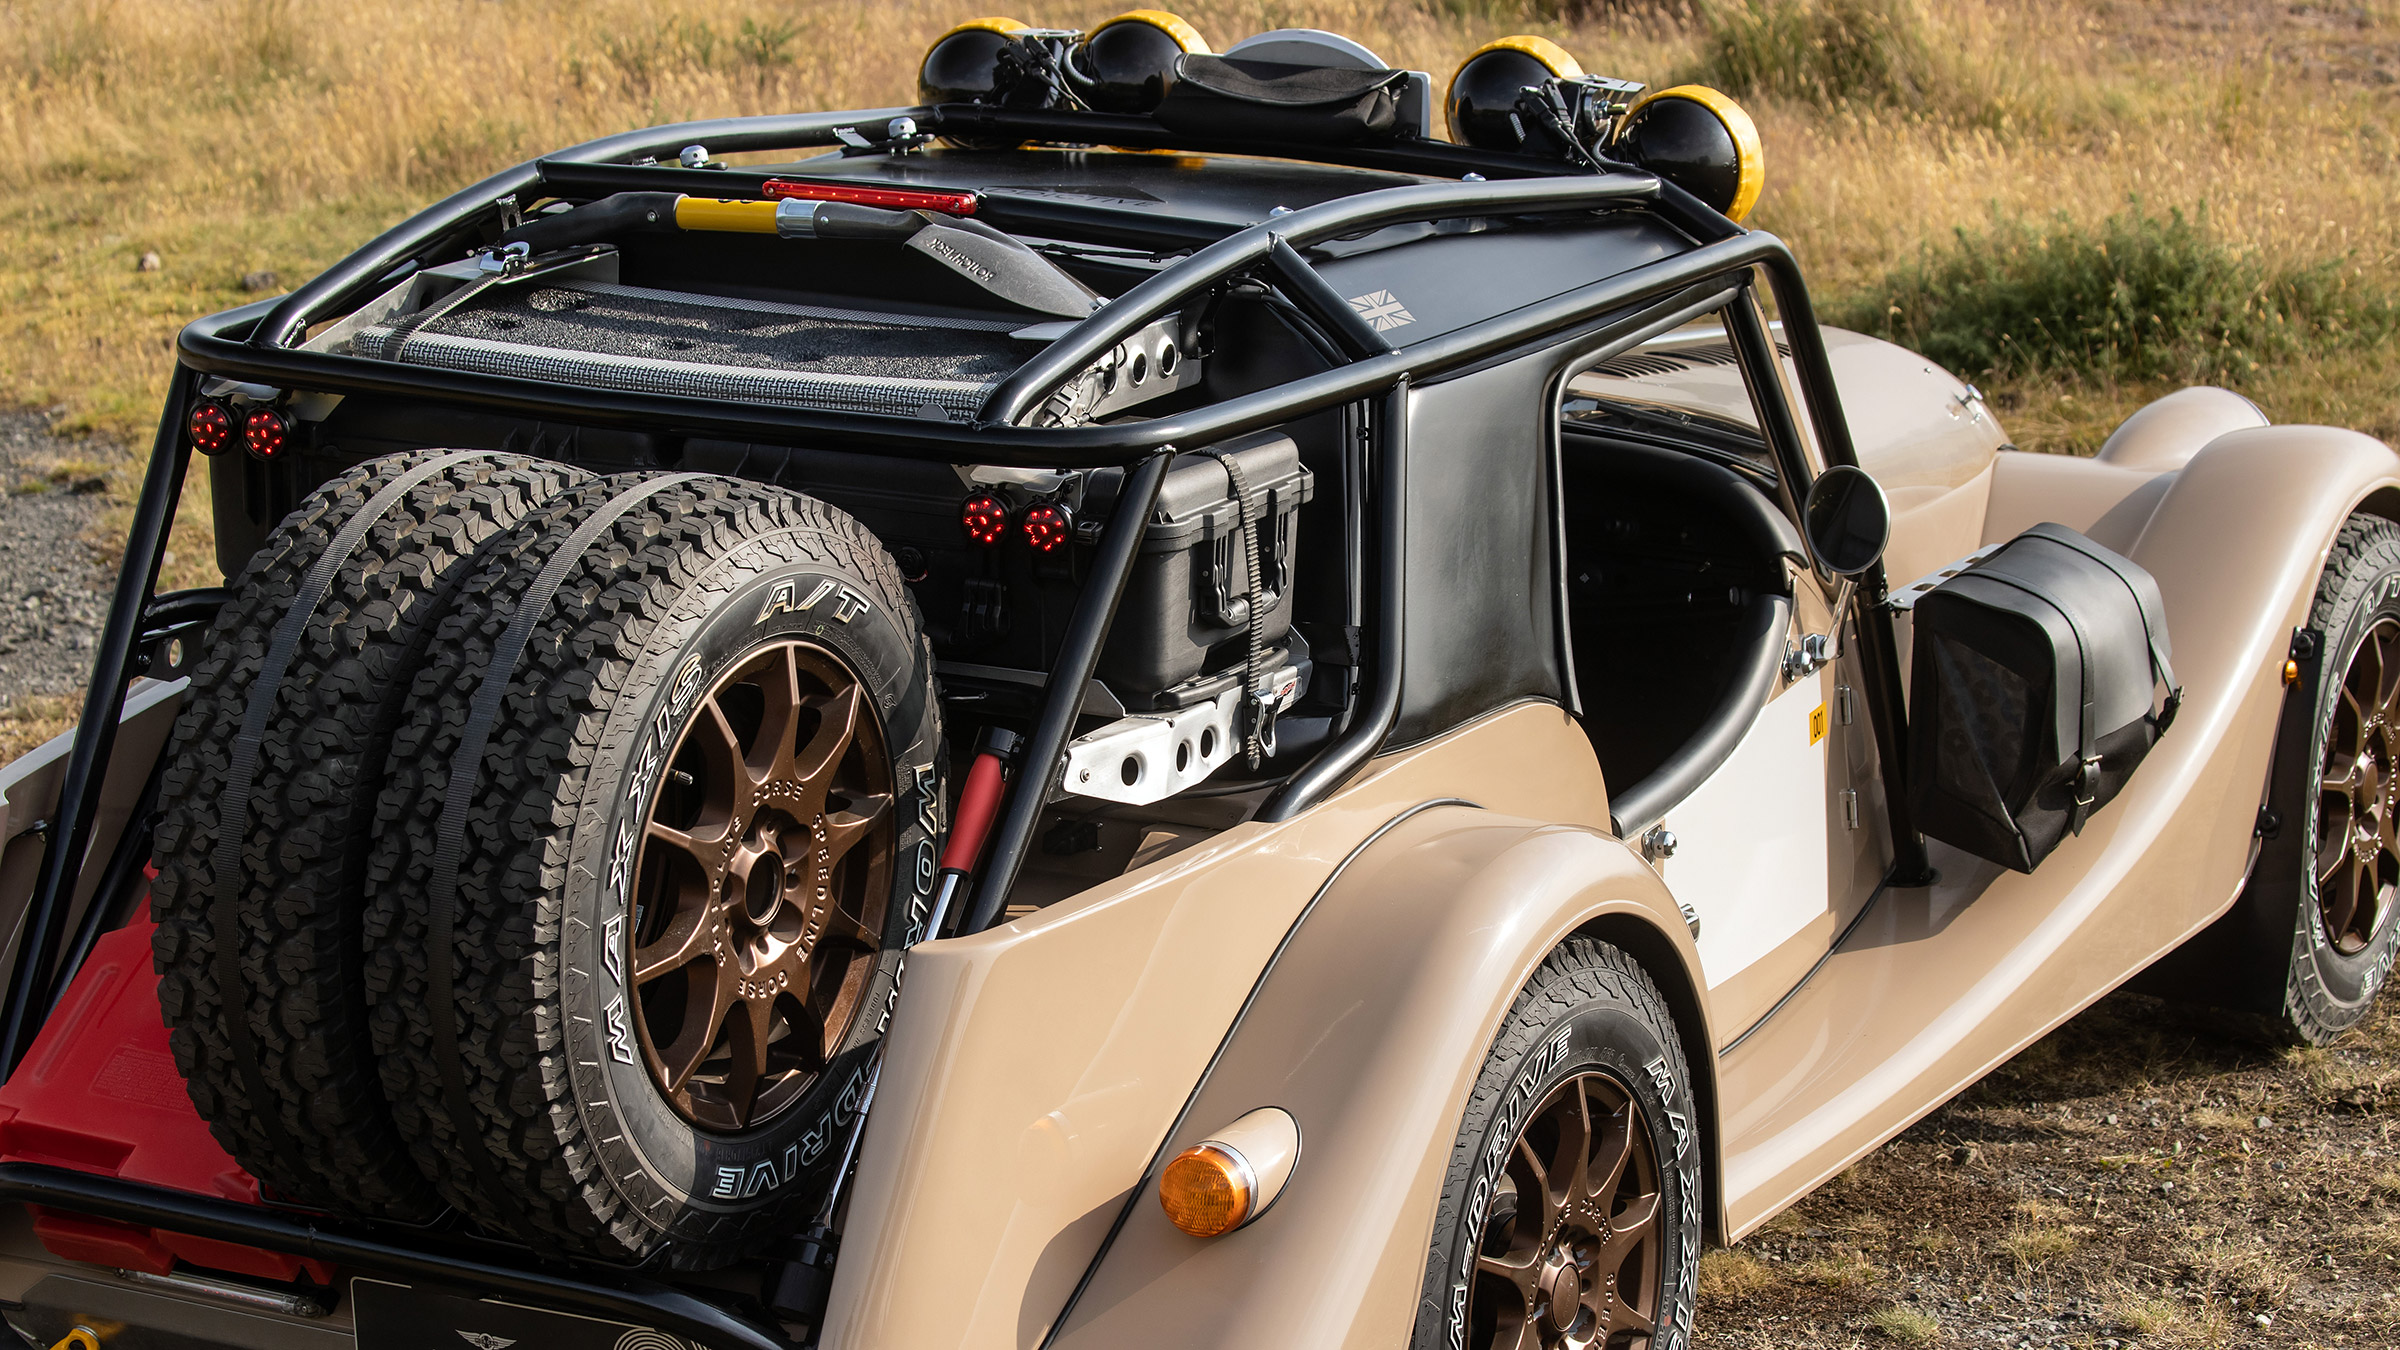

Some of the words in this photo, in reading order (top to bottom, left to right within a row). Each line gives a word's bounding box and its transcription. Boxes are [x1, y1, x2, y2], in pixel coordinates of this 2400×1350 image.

[930, 237, 997, 282] ROUGHNECK
[753, 579, 871, 625] A/T
[752, 780, 804, 807] CORSE
[602, 653, 703, 1066] MAXXIS
[796, 813, 830, 963] SPEEDLINE
[737, 969, 788, 999] CORSE
